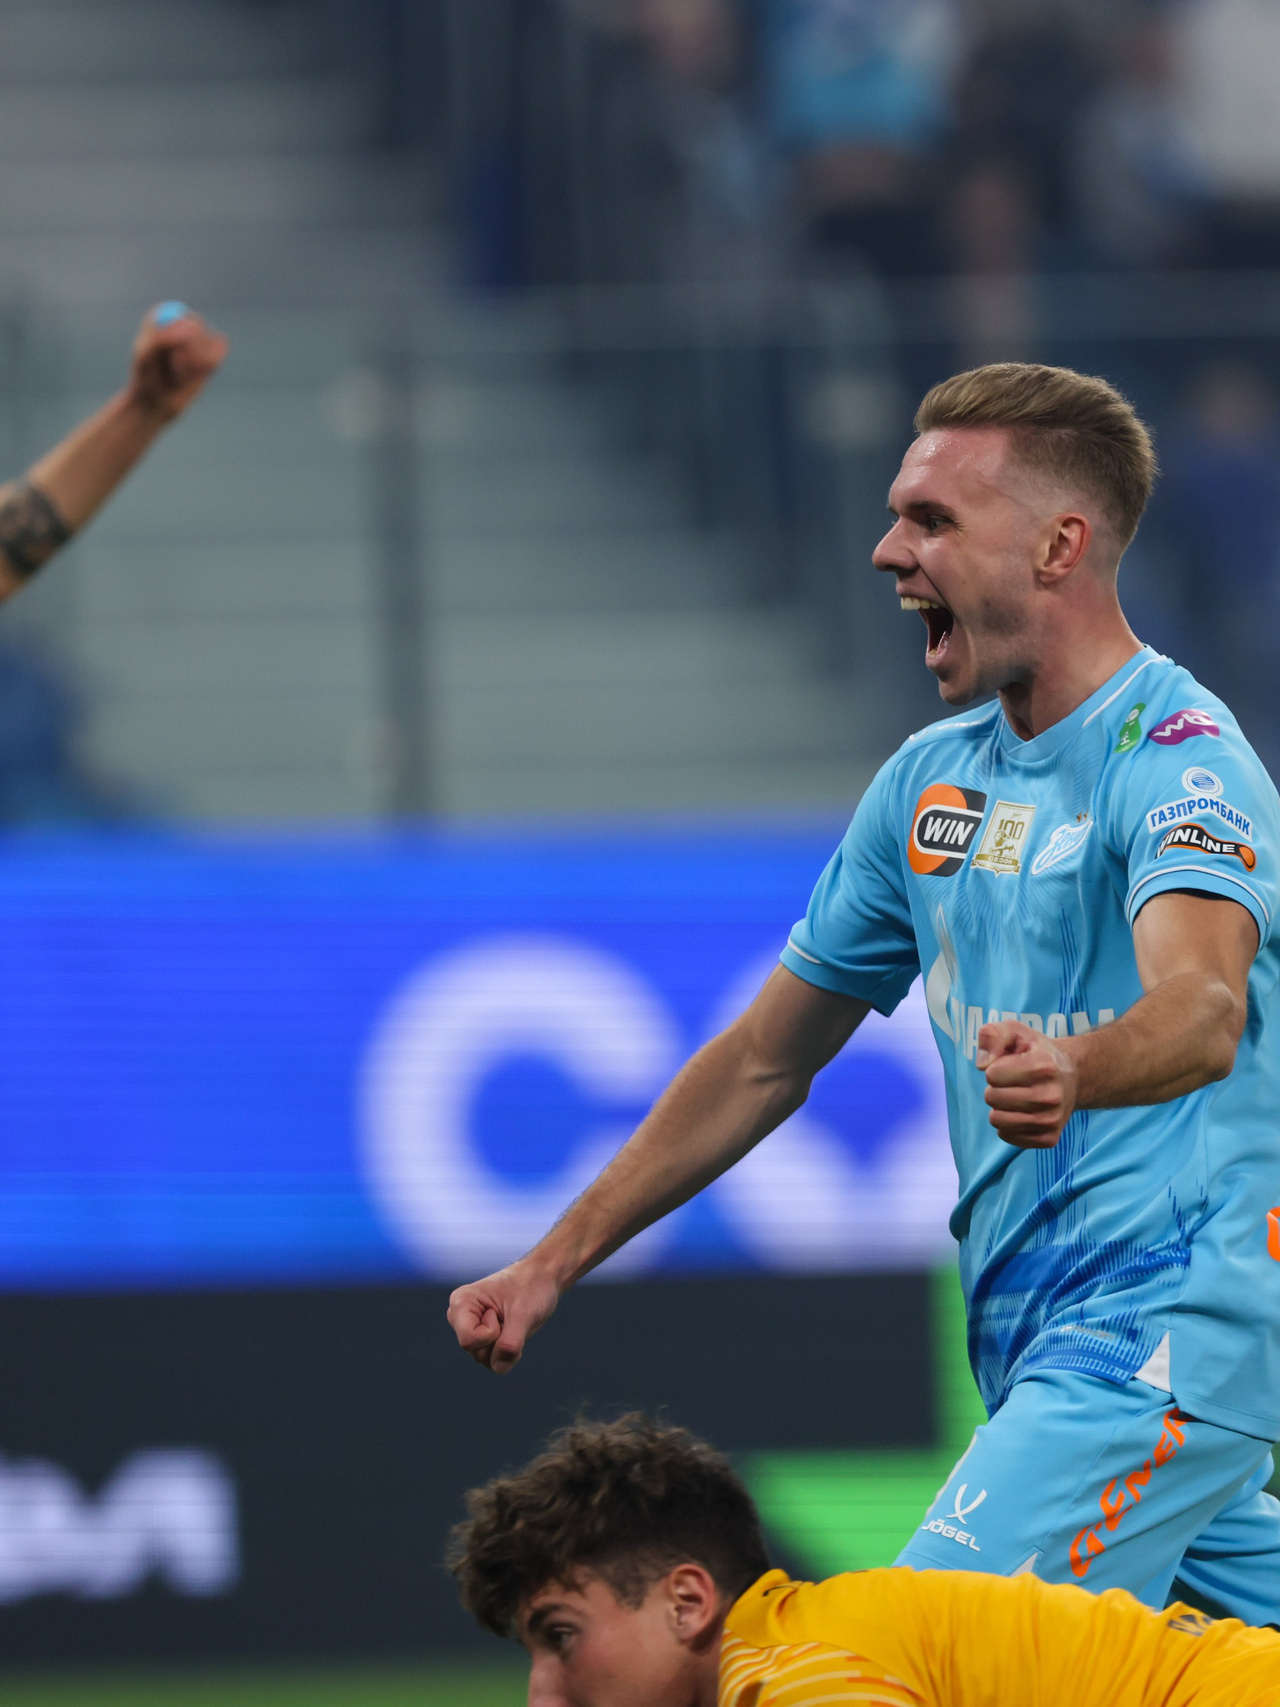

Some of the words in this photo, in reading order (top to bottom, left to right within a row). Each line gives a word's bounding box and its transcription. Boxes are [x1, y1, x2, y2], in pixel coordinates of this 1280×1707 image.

[923, 816, 975, 846] WIN
[998, 818, 1025, 840] 100
[1150, 797, 1251, 836] ГАЗПРОМБАНК
[921, 1518, 981, 1552] JÖGEL
